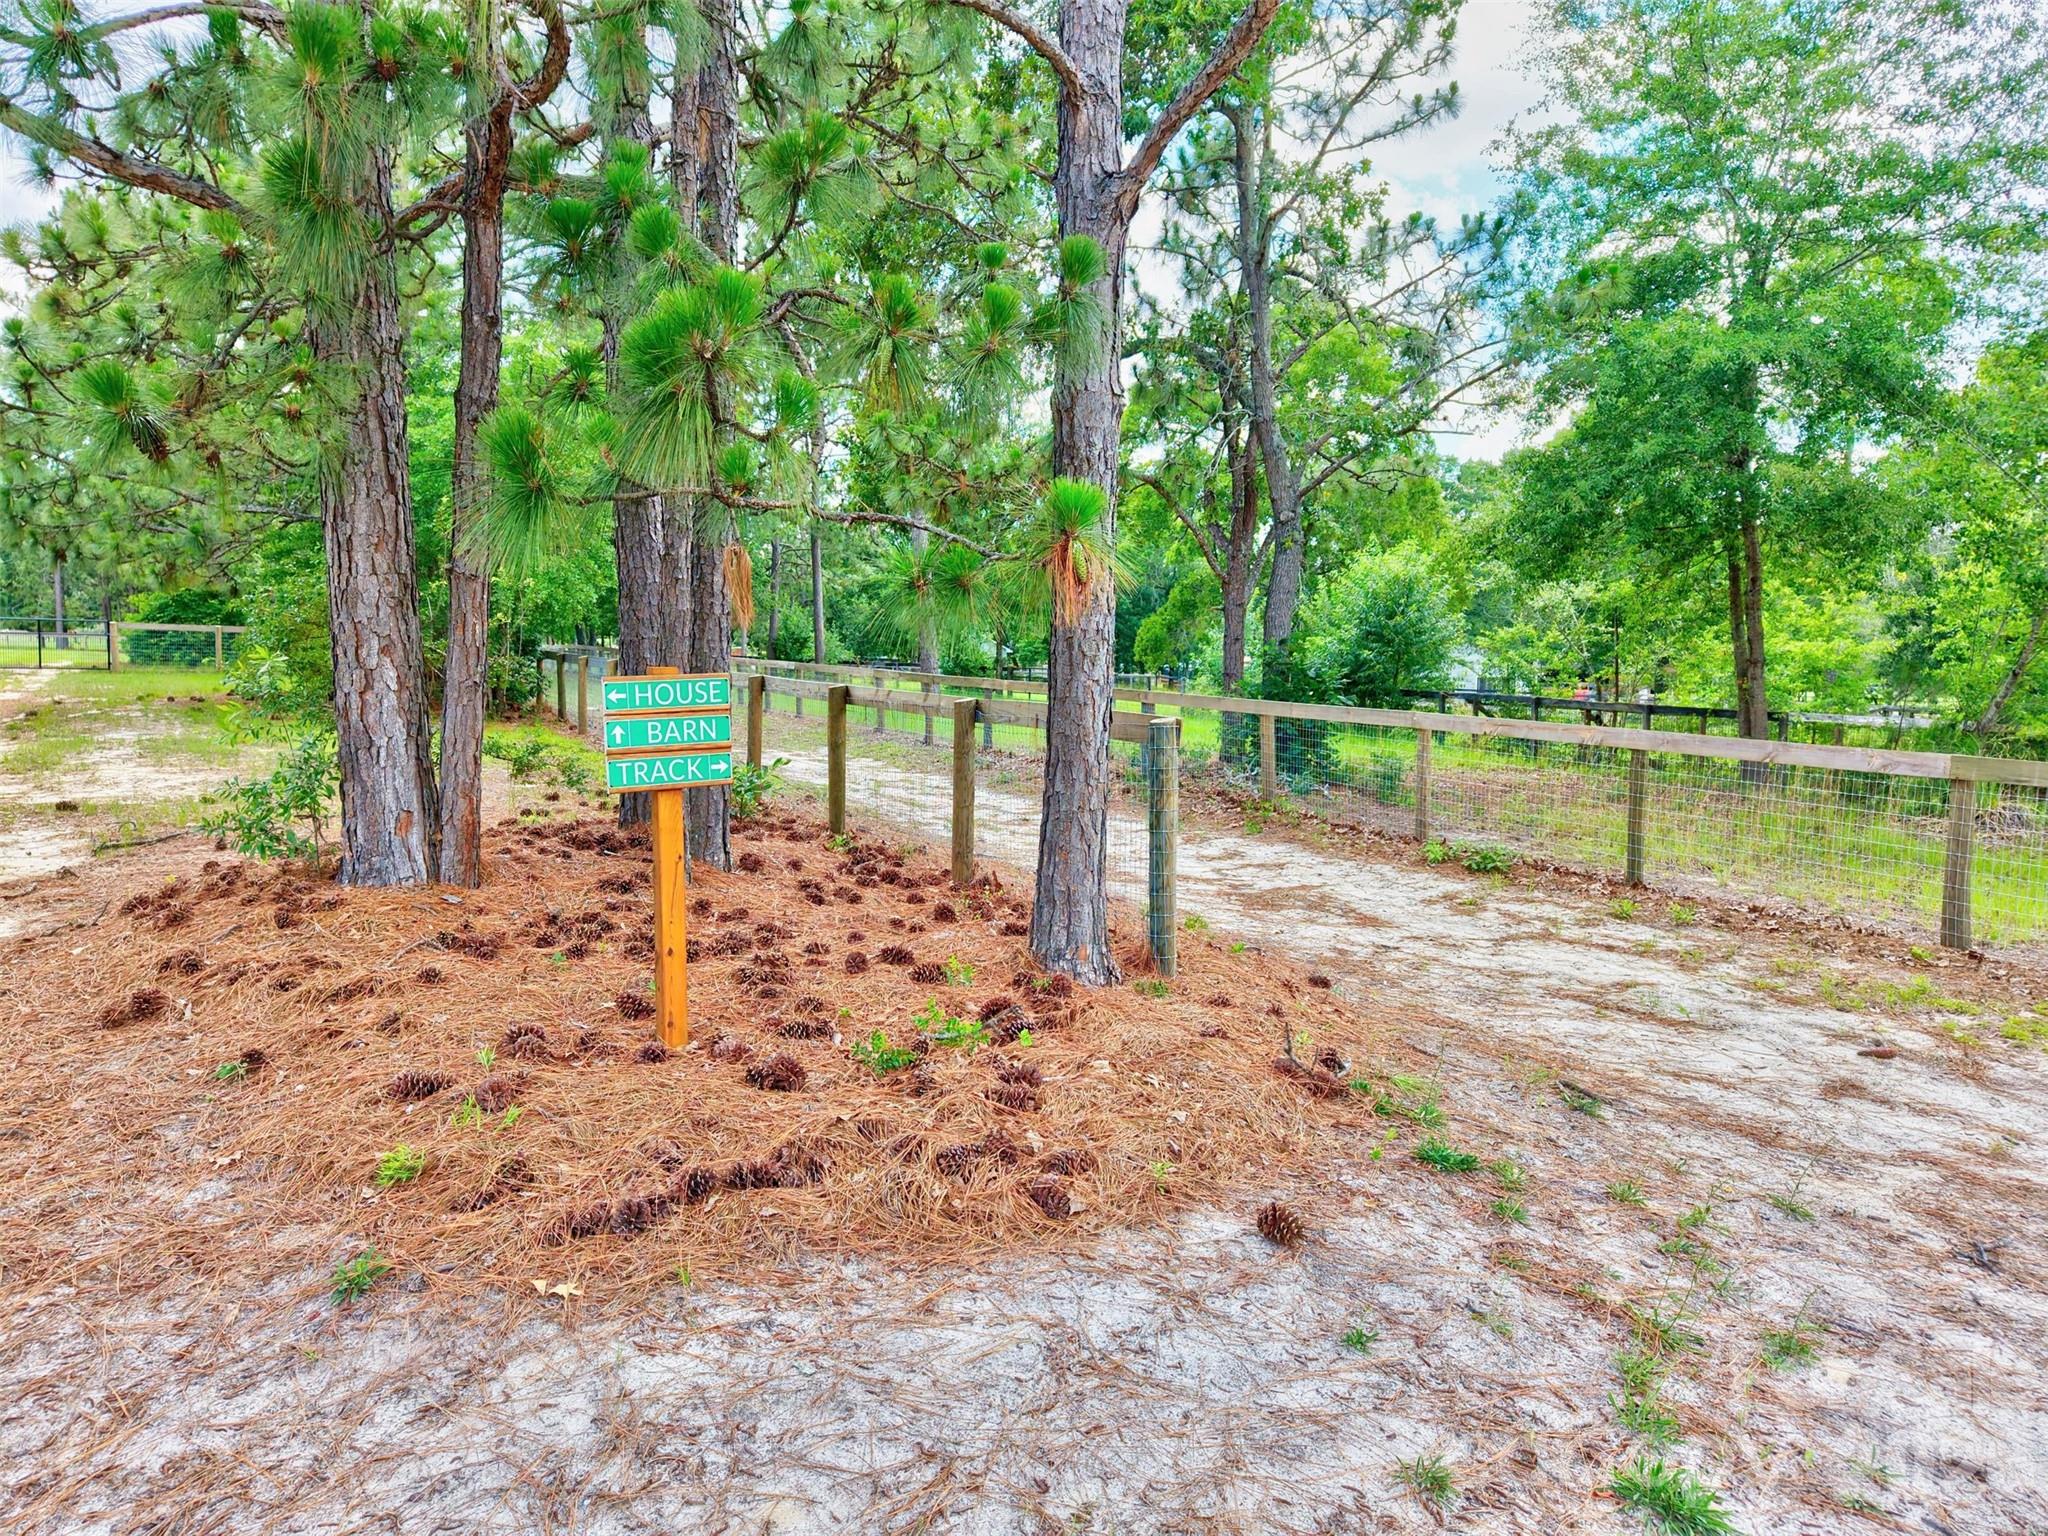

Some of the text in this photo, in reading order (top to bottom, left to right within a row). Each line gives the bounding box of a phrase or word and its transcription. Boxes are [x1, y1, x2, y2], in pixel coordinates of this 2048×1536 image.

[634, 681, 722, 706] HOUSE
[647, 719, 717, 744] BARN
[616, 757, 704, 785] TRACK
